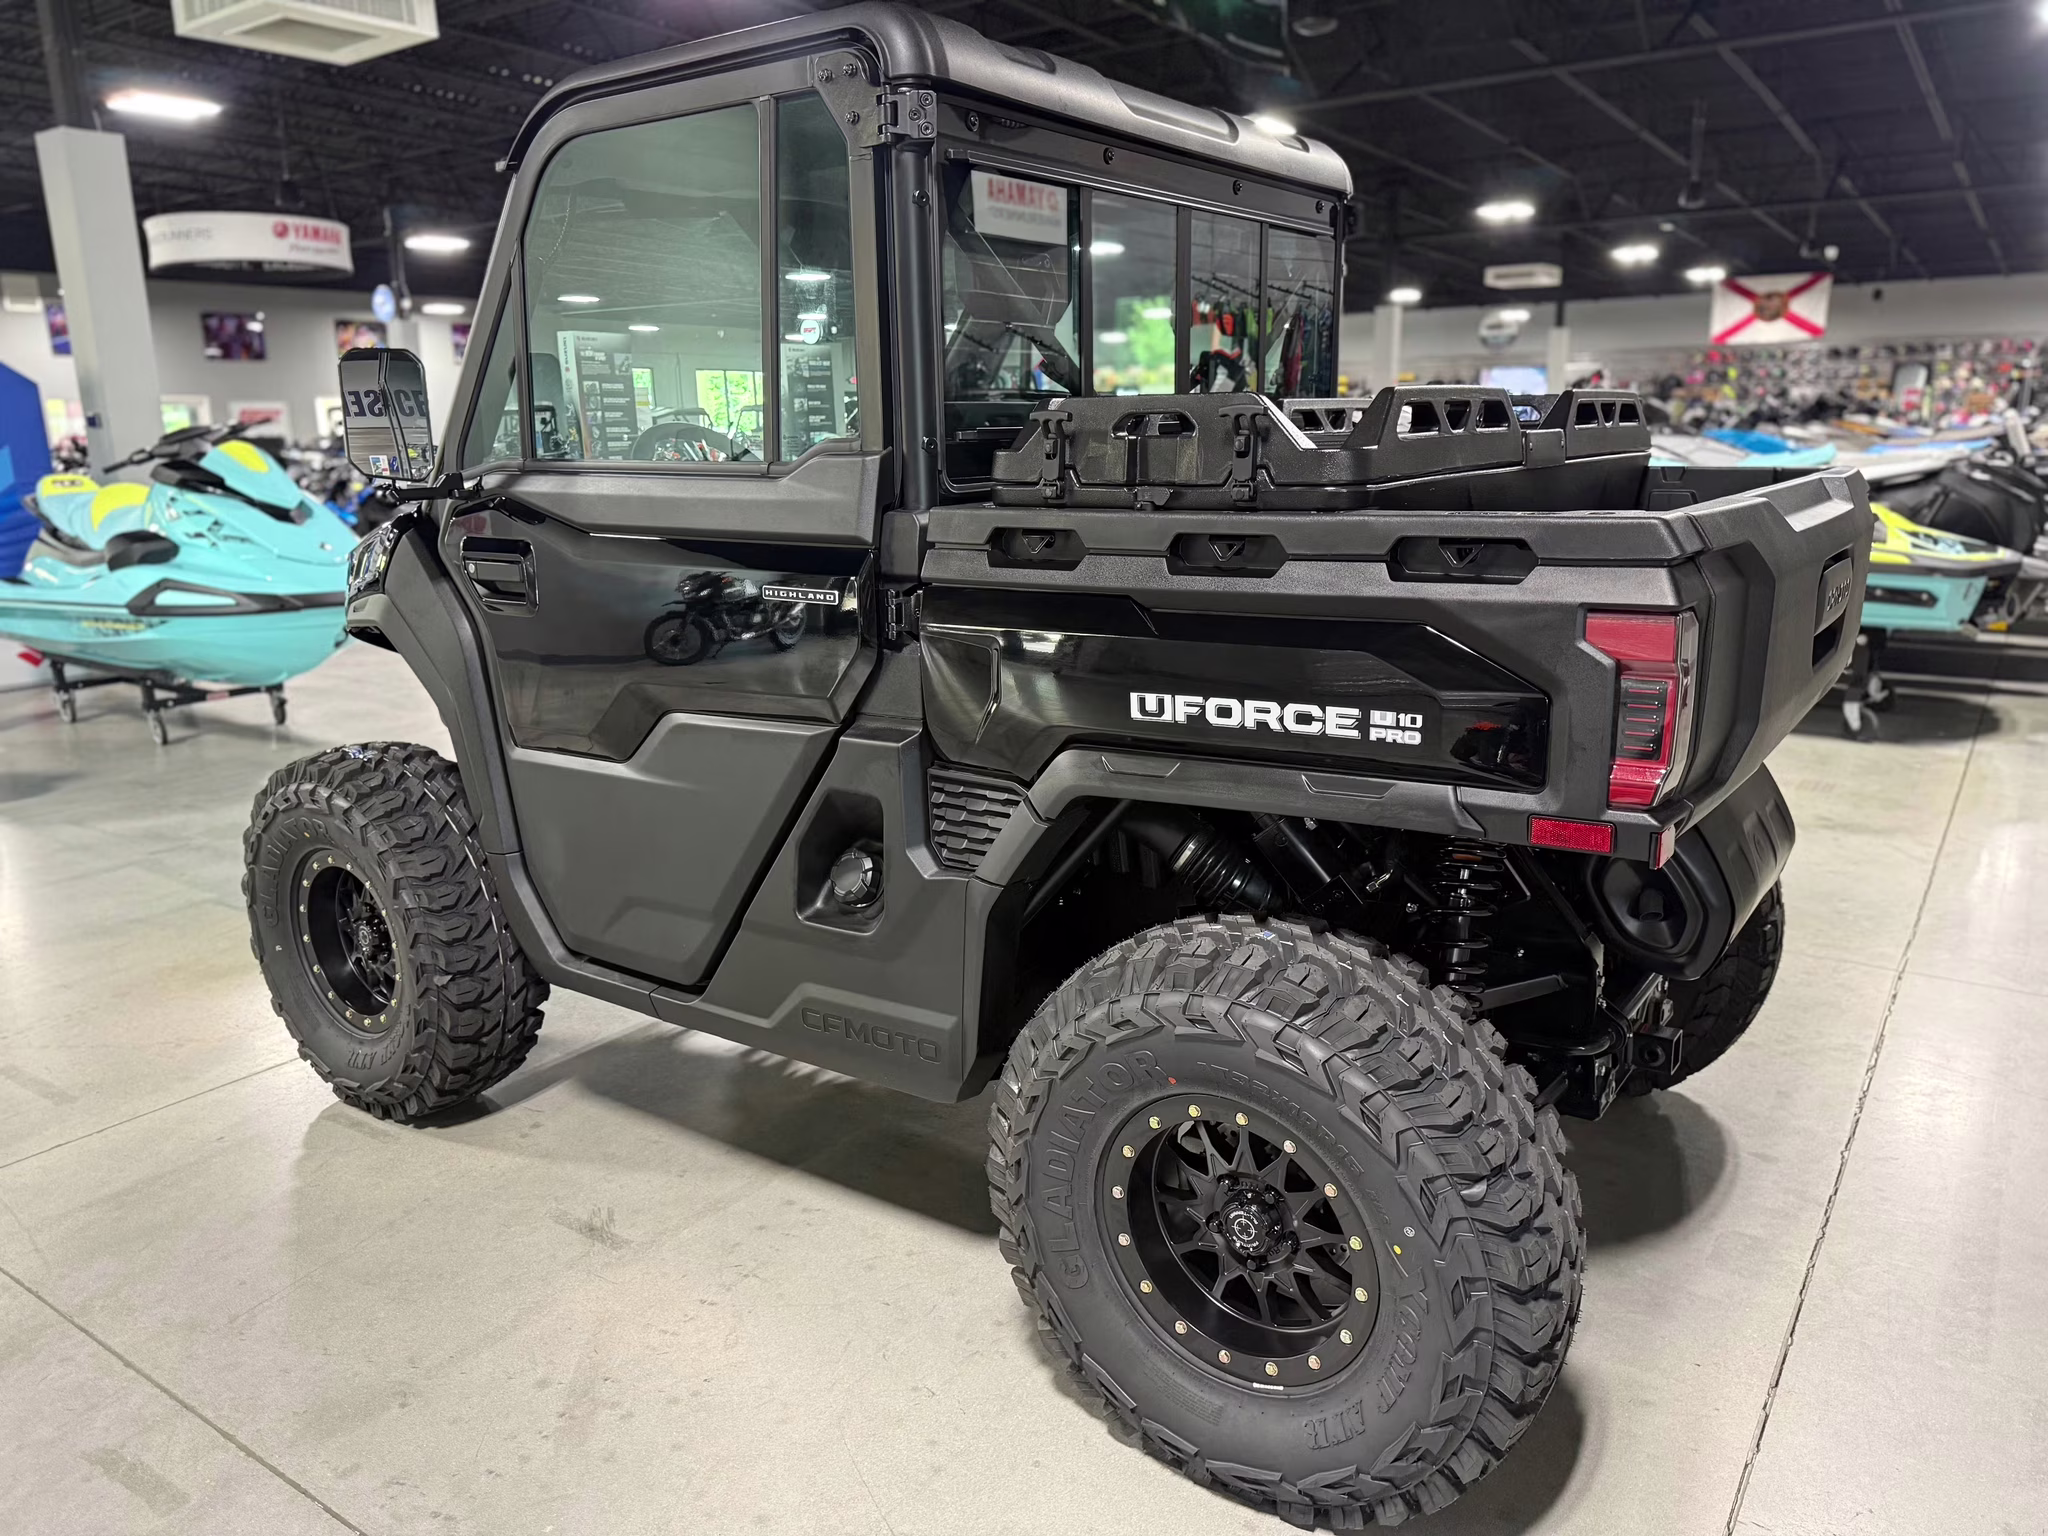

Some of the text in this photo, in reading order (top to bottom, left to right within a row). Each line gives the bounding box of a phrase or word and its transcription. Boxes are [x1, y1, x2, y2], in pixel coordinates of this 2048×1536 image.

[765, 589, 834, 601] HIGHLAND
[1129, 691, 1362, 739] UFORCE
[1369, 727, 1422, 745] PRO
[801, 1007, 942, 1065] CFMOTO
[1041, 1049, 1172, 1290] GLADIATOR
